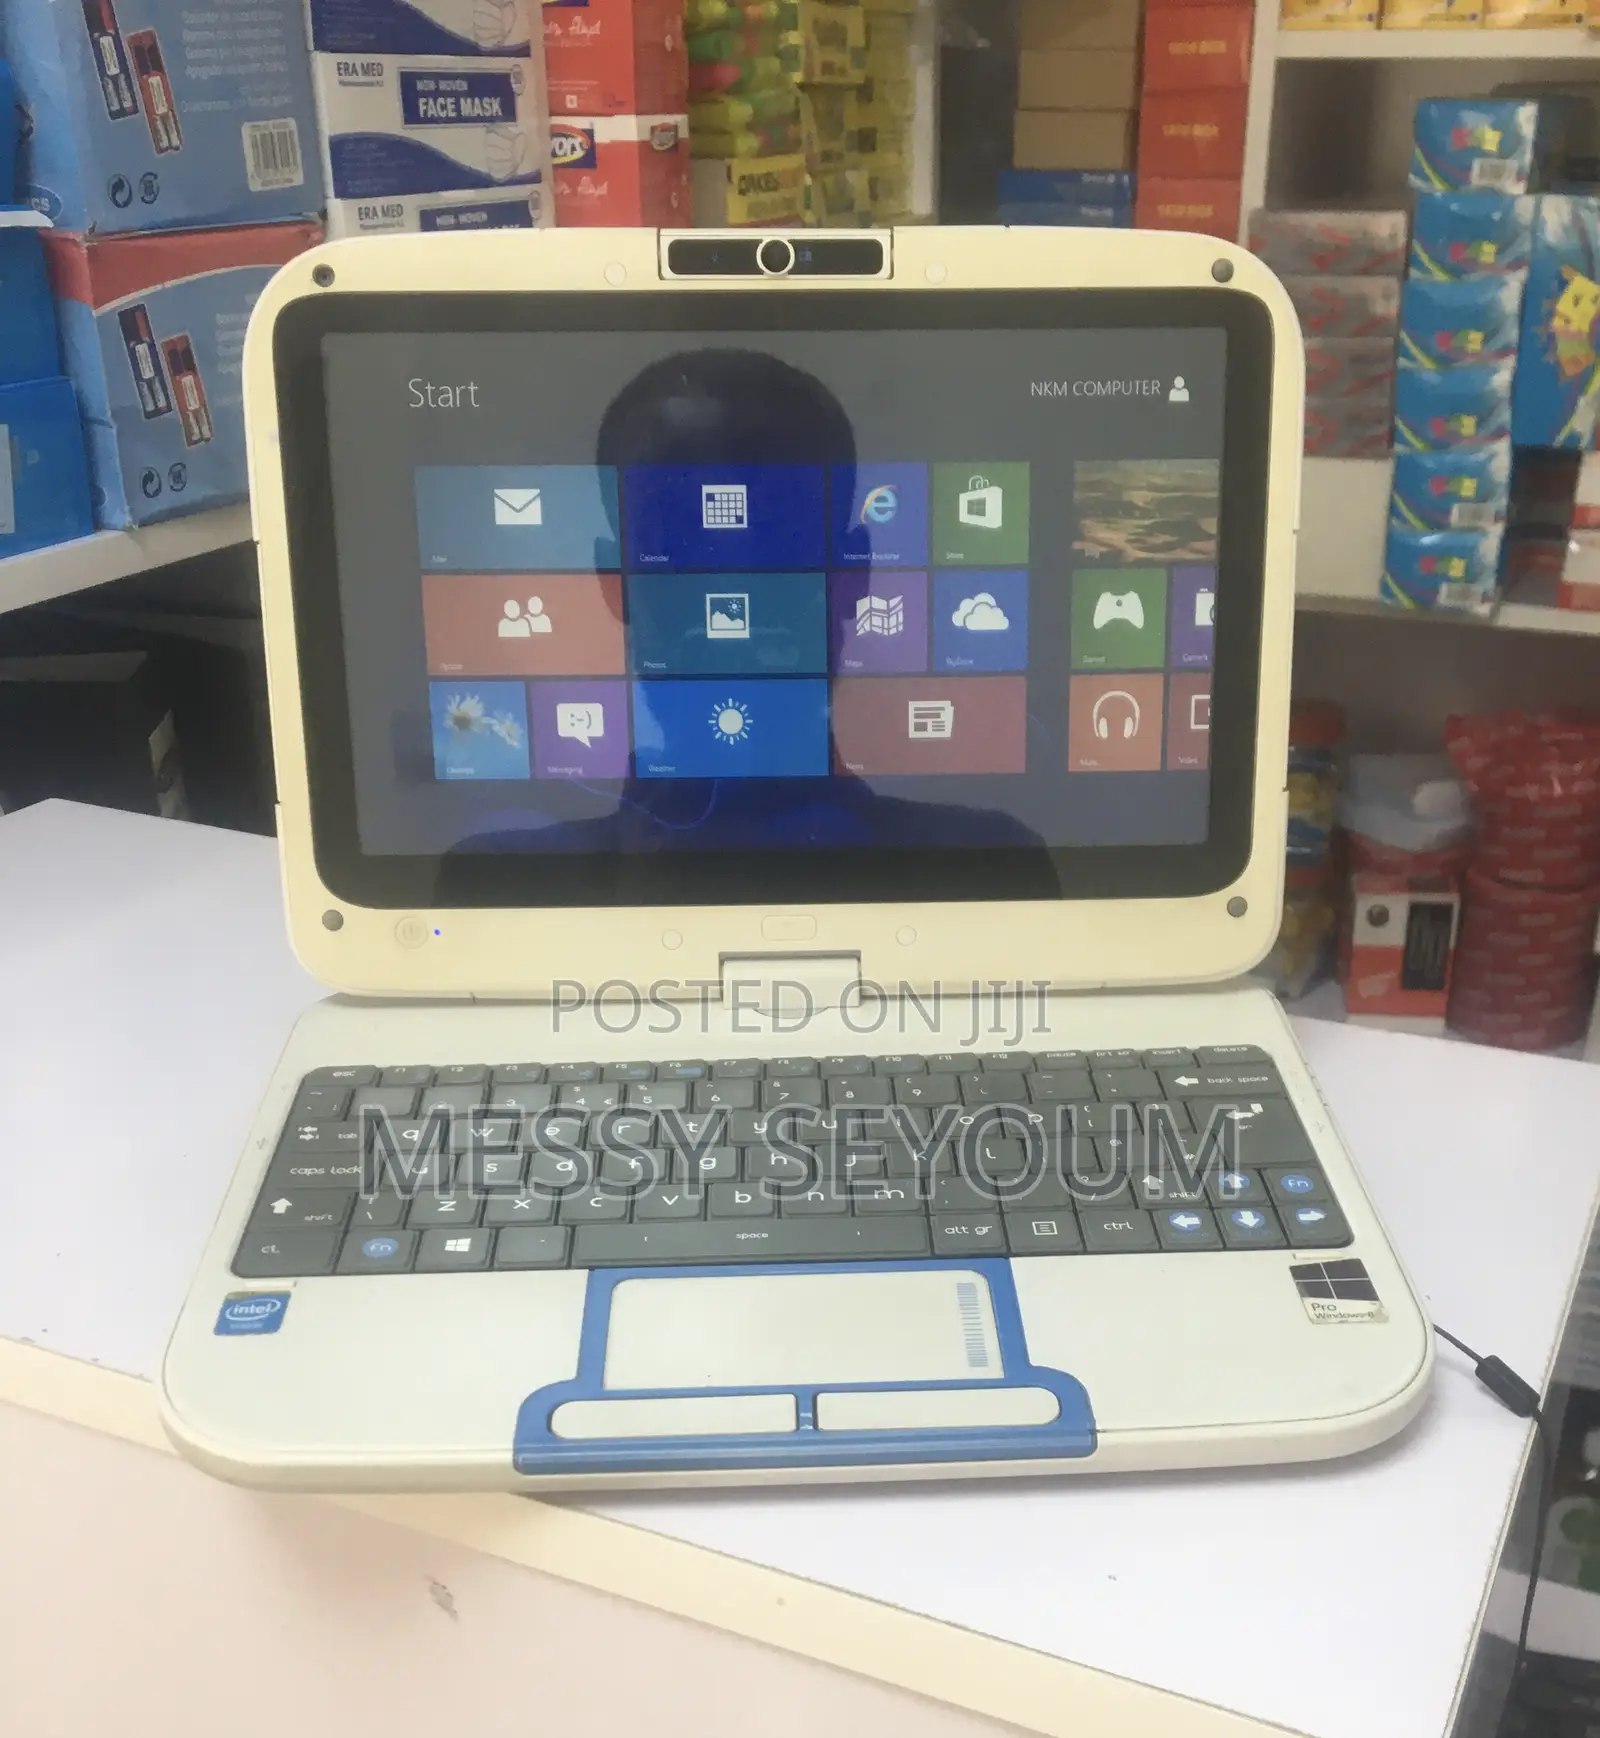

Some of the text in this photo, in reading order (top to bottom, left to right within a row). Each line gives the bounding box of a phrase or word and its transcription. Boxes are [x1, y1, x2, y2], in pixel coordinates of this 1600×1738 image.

[337, 62, 384, 77] ERA MED
[419, 96, 502, 118] FACE MASK
[358, 204, 404, 220] ERA MED
[408, 378, 480, 408] Start
[1031, 380, 1161, 396] NKM COMPUTER
[1238, 1075, 1269, 1084] space
[780, 1092, 790, 1100] 7
[846, 1090, 855, 1099] 8
[912, 1088, 922, 1097] 9
[506, 1099, 517, 1107] 3
[575, 1098, 586, 1106] 4
[643, 1095, 653, 1105] 5
[711, 1095, 721, 1103] 6
[617, 1125, 631, 1134] r
[686, 1121, 698, 1133] t
[753, 1122, 768, 1135] y
[821, 1120, 837, 1129] u
[338, 1131, 359, 1140] tab
[402, 1129, 420, 1142] q
[545, 1127, 561, 1136] e
[700, 1158, 716, 1170] g
[771, 1153, 787, 1165] h
[845, 1152, 856, 1167] j
[290, 1165, 363, 1177] caps lock
[486, 1163, 498, 1173] s
[735, 1191, 752, 1204] b
[807, 1191, 824, 1201] n
[874, 1189, 905, 1199] m
[513, 1199, 531, 1209] x
[590, 1197, 602, 1207] c
[662, 1195, 679, 1206] v
[944, 1225, 993, 1236] alt gr
[1103, 1221, 1134, 1231] ctrl
[735, 1232, 769, 1241] space
[233, 1303, 272, 1315] intel
[1311, 1302, 1337, 1311] Pro
